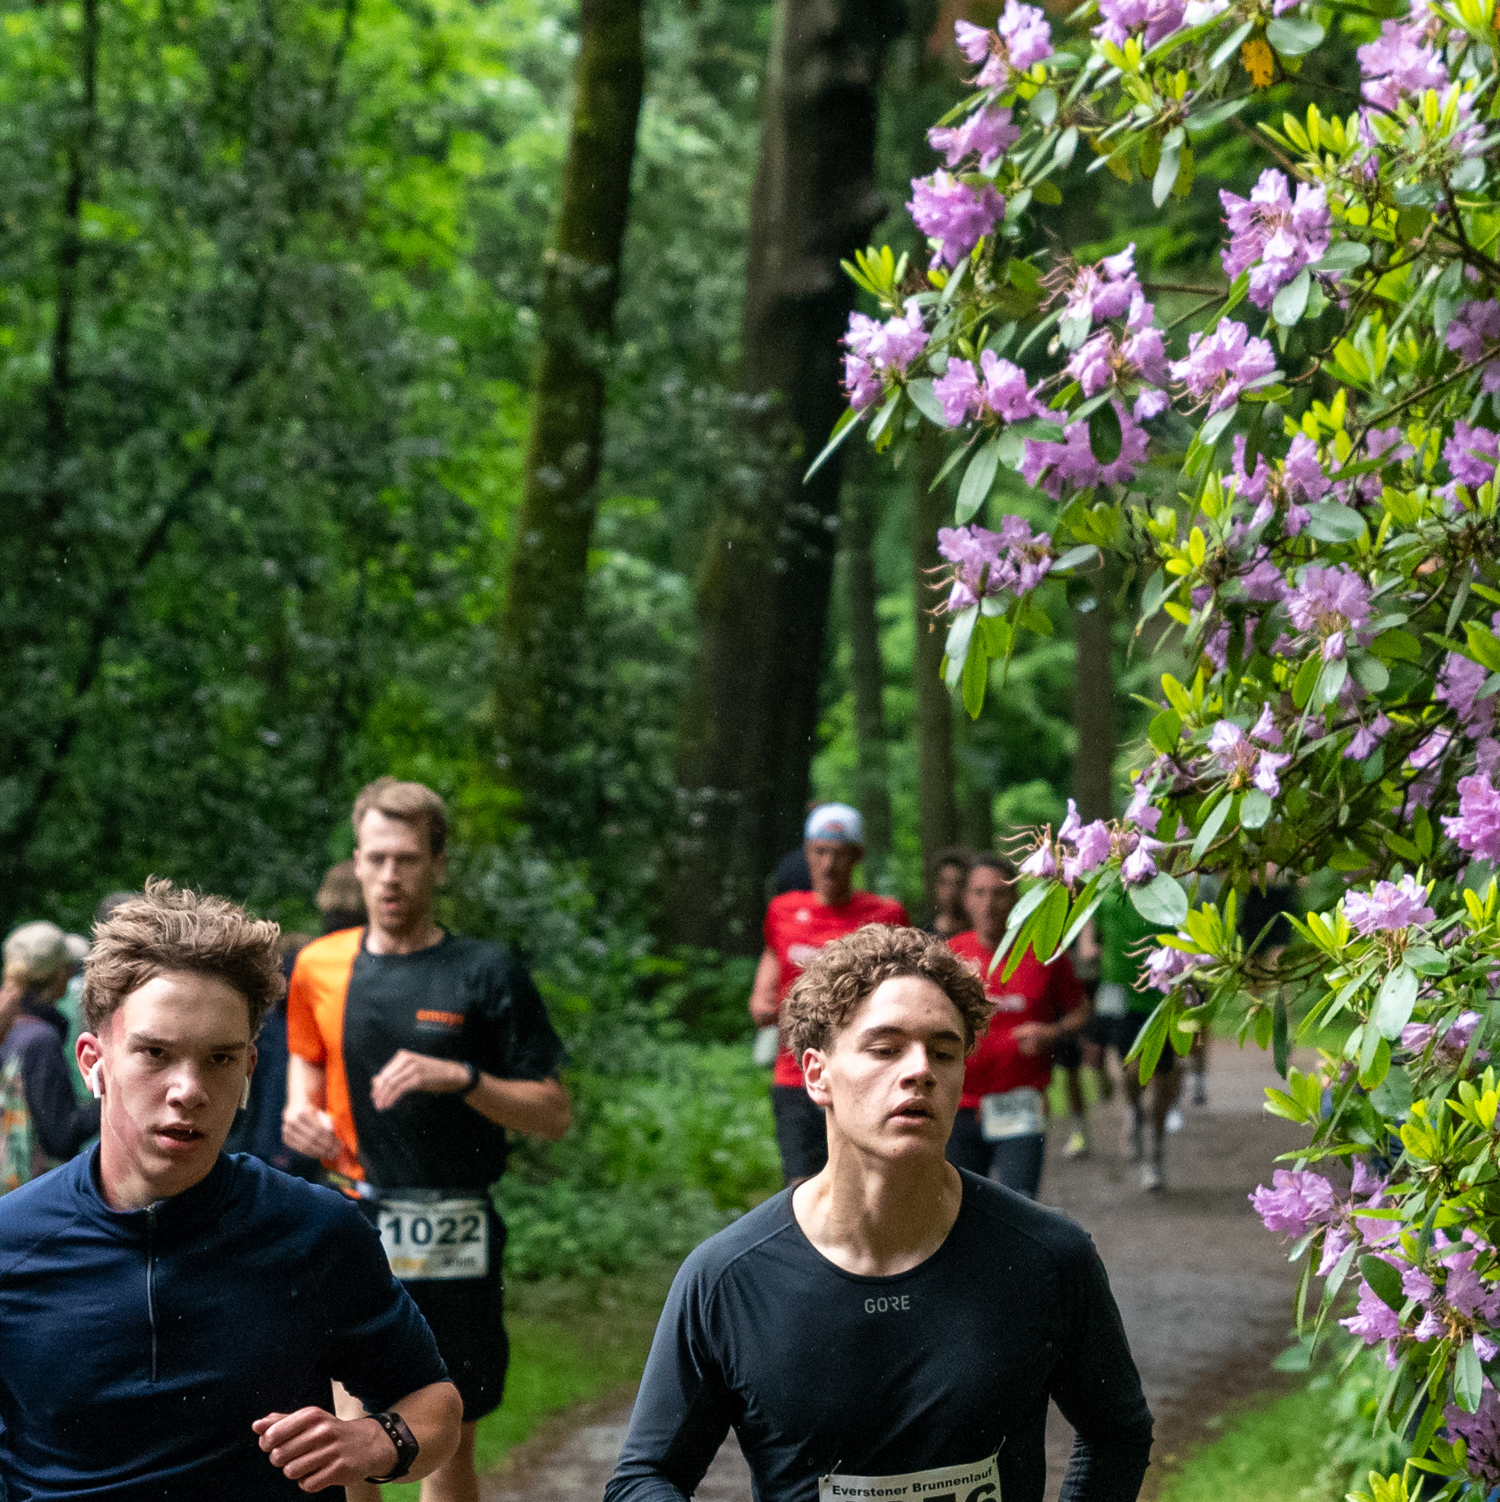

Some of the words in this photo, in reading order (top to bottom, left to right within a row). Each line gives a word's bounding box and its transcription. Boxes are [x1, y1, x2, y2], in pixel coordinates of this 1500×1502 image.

[385, 1215, 481, 1246] 1022
[864, 1295, 911, 1314] GORE
[832, 1485, 908, 1498] Everstener
[912, 1466, 994, 1493] Brunnenlauf
